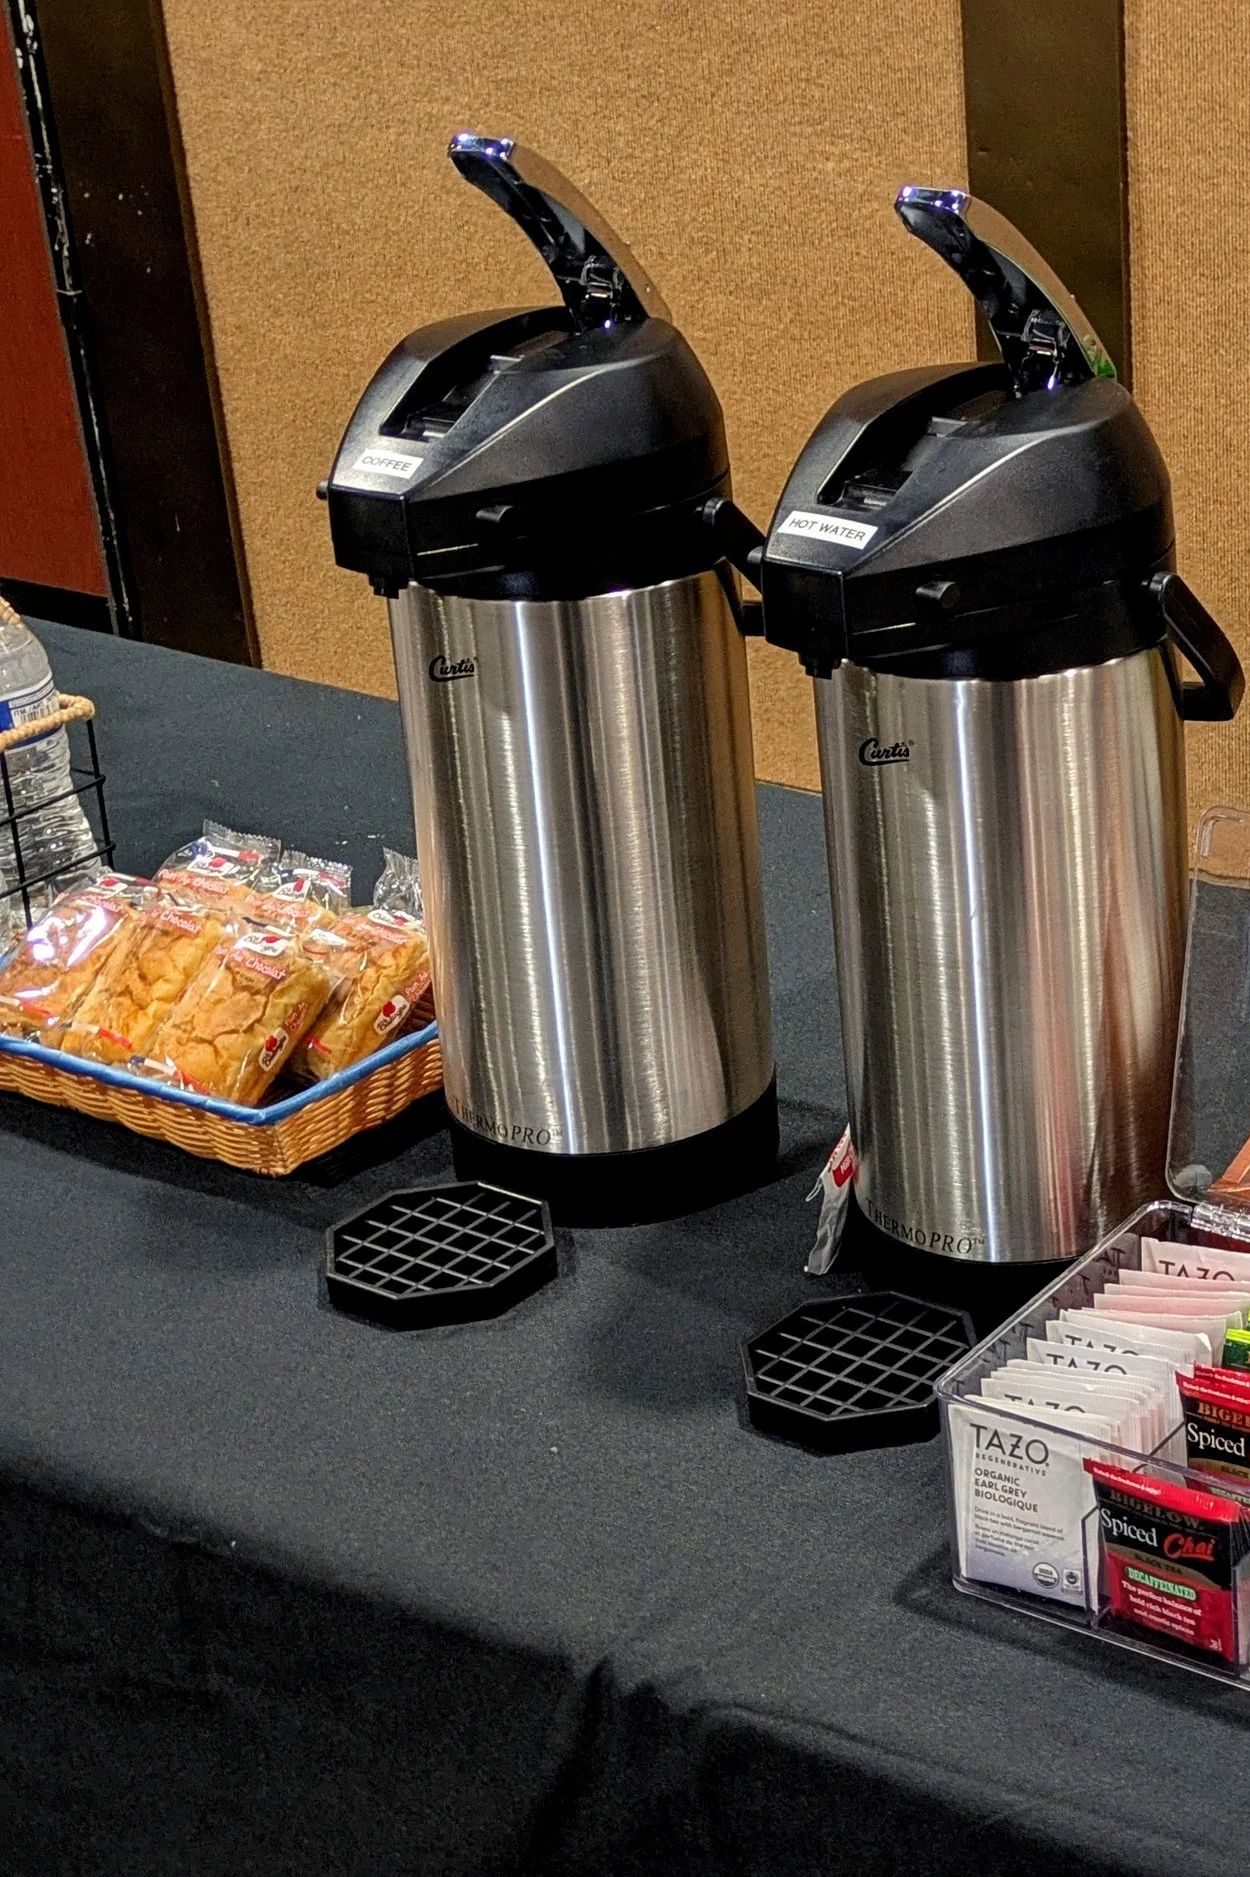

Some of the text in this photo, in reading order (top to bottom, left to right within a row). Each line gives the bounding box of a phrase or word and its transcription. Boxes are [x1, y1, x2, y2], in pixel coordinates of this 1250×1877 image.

[362, 456, 412, 472] COFFEE
[788, 518, 866, 541] HOT WATER
[429, 655, 476, 682] Curtis
[859, 738, 911, 766] Curtis
[245, 957, 286, 980] Chocolat
[970, 1423, 1050, 1466] TAZO
[1187, 1422, 1246, 1457] Spiced
[974, 1467, 1021, 1487] ORGANIC
[975, 1453, 1047, 1477] REGENERATIVE
[974, 1478, 1027, 1499] EARL GREY
[974, 1488, 1039, 1513] BIOLOGIQUE
[1109, 1489, 1202, 1529] BIGELOW
[1101, 1507, 1158, 1547] Spiced
[1163, 1533, 1216, 1562] Chai
